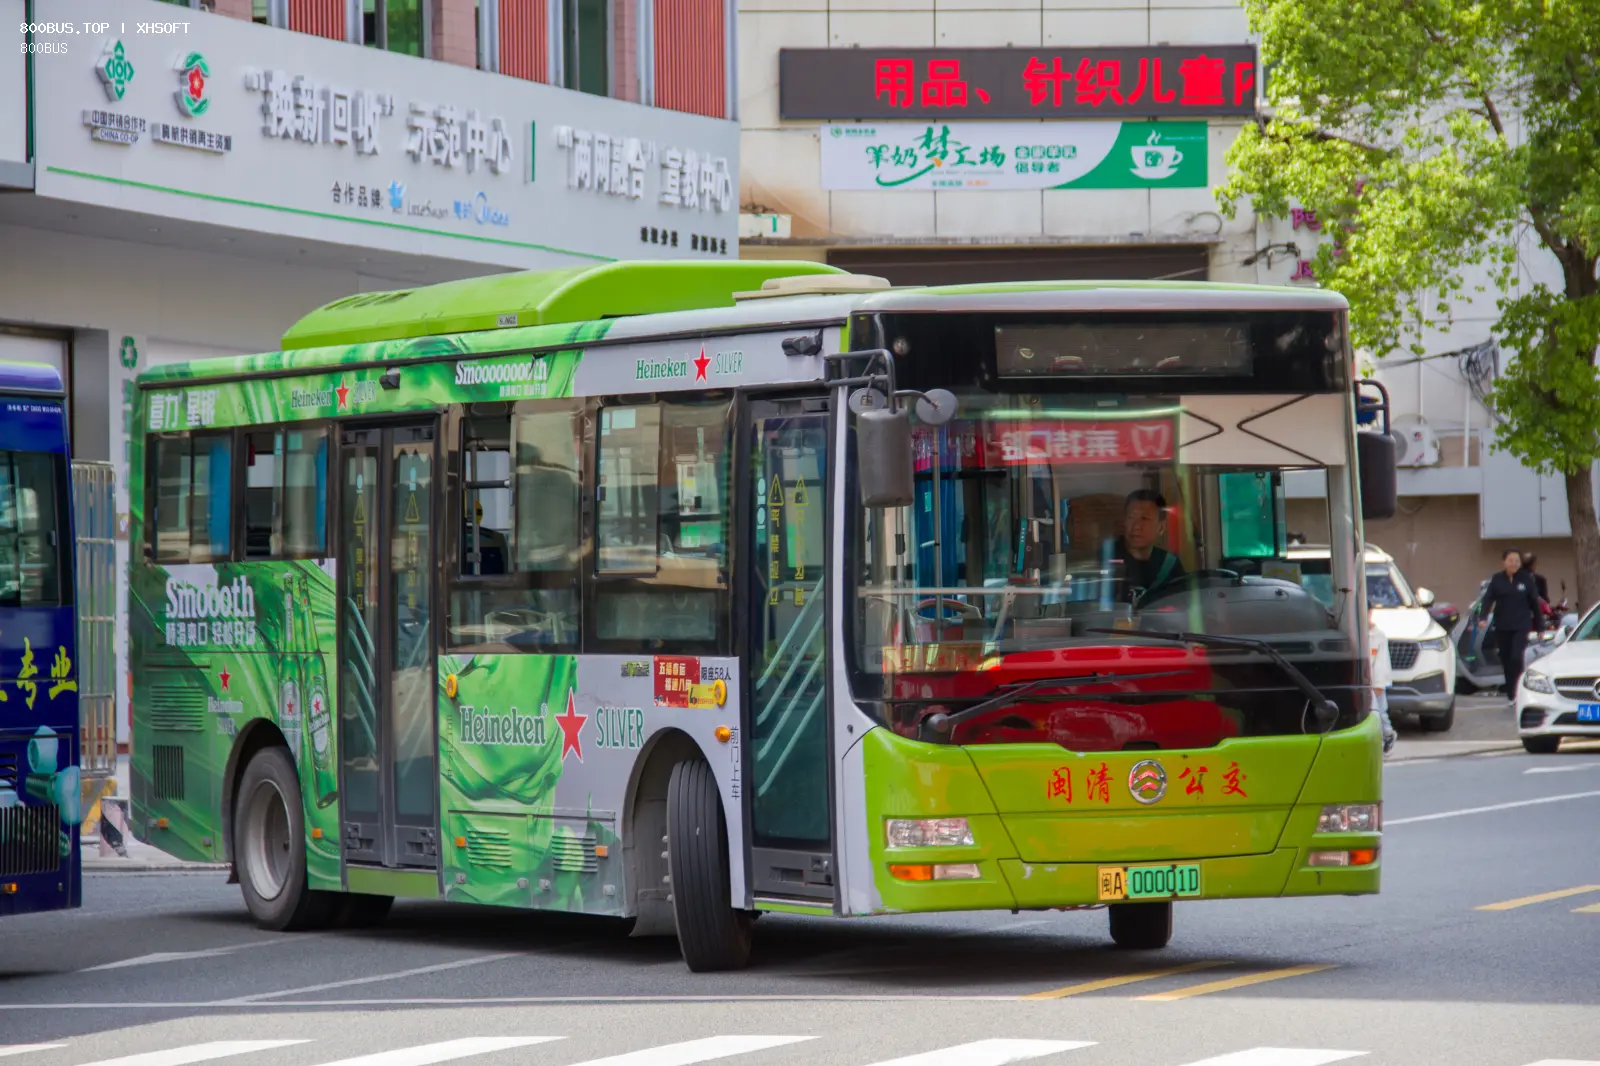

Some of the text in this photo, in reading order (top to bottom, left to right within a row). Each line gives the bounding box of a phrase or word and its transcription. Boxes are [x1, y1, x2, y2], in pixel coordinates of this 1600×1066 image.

[92, 110, 146, 132] 中国供销合作社
[100, 129, 119, 141] CHINA
[406, 101, 514, 175] 示范中心
[636, 352, 743, 380] Heineken SILVER
[0, 636, 77, 710] 专业
[460, 706, 646, 749] Heineken SILVER
[1048, 761, 1247, 804] 闽清 公交
